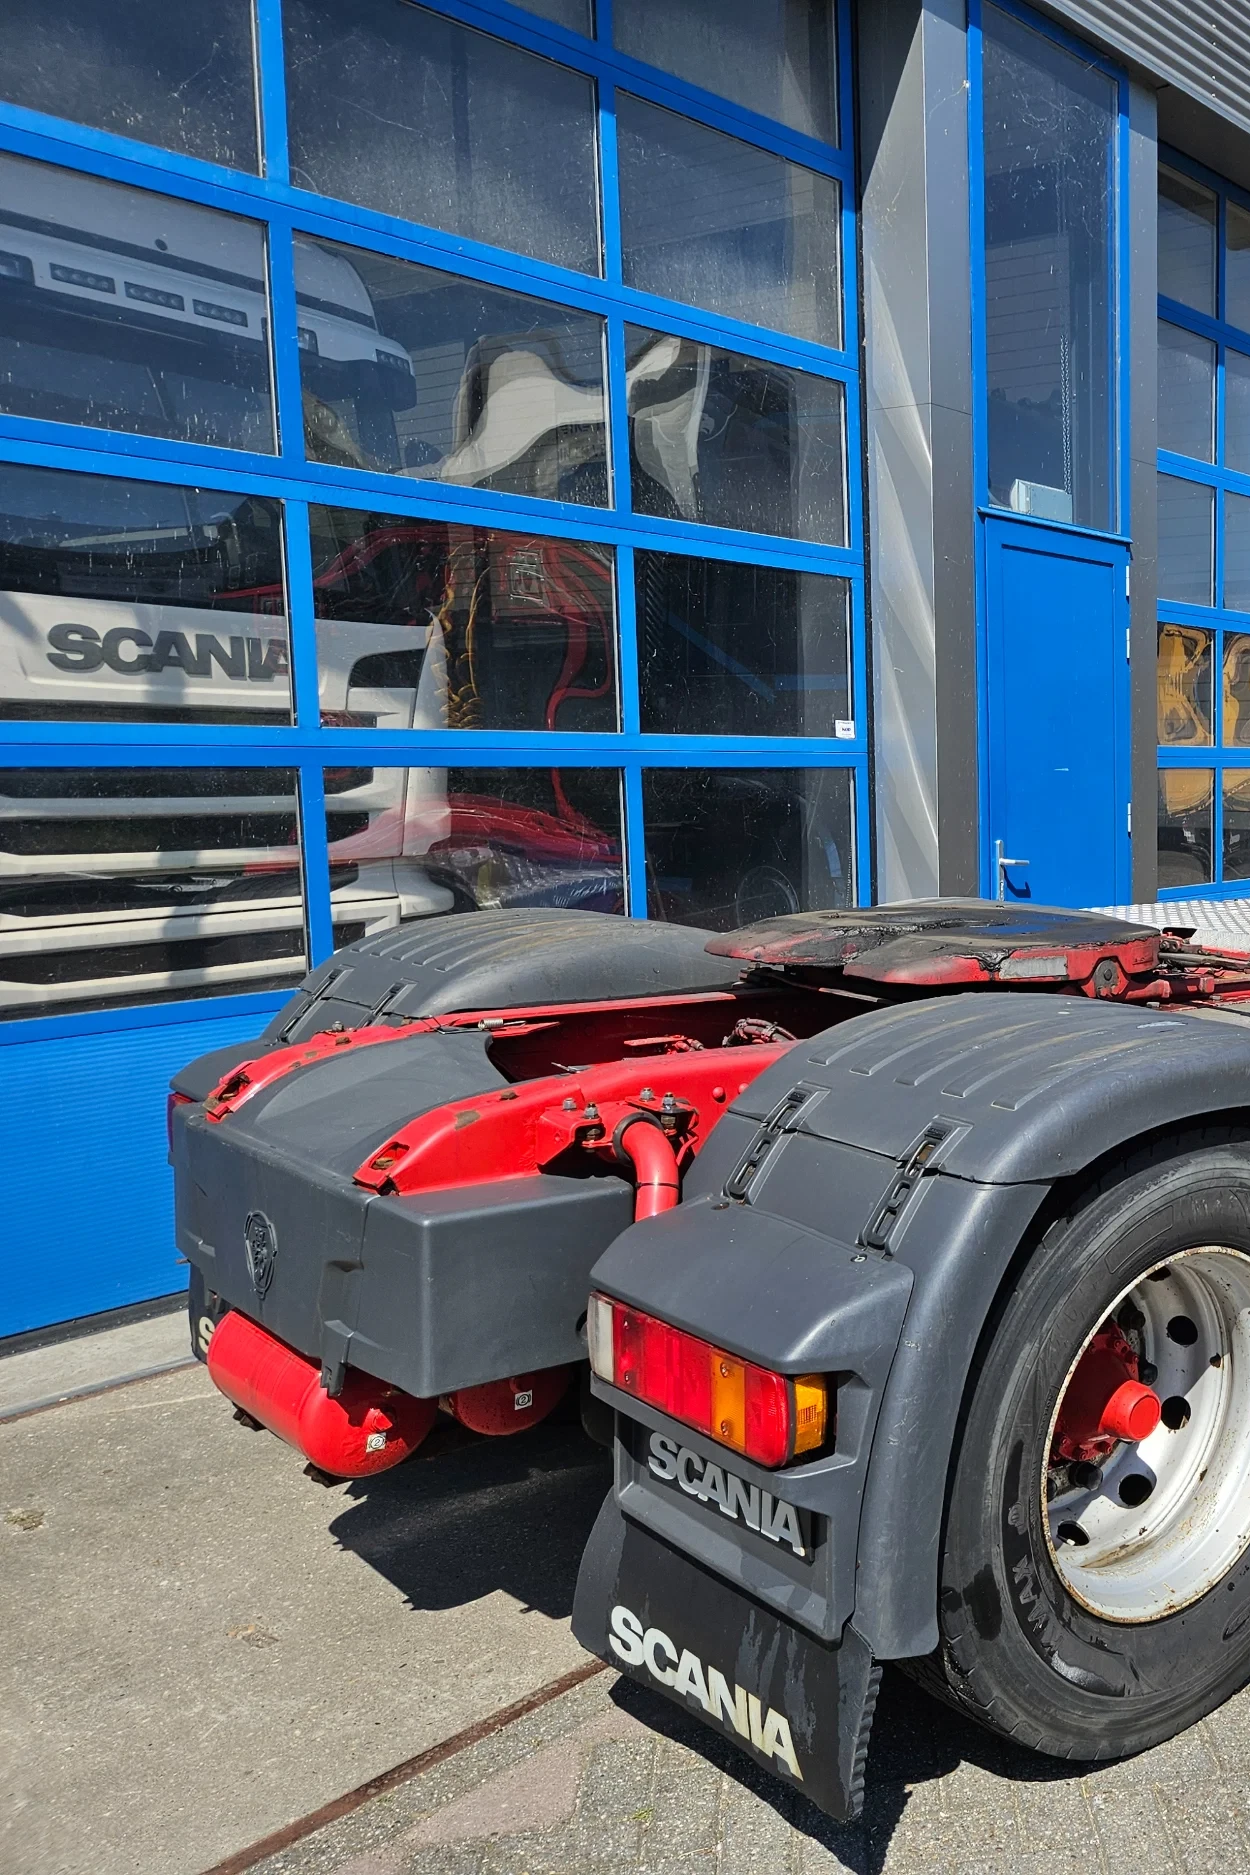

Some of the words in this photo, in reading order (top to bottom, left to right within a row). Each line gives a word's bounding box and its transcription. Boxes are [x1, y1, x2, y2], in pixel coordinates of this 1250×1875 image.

[46, 623, 288, 681] SCANIA
[648, 1432, 805, 1556] SCANIA
[609, 1605, 804, 1781] SCANIA
